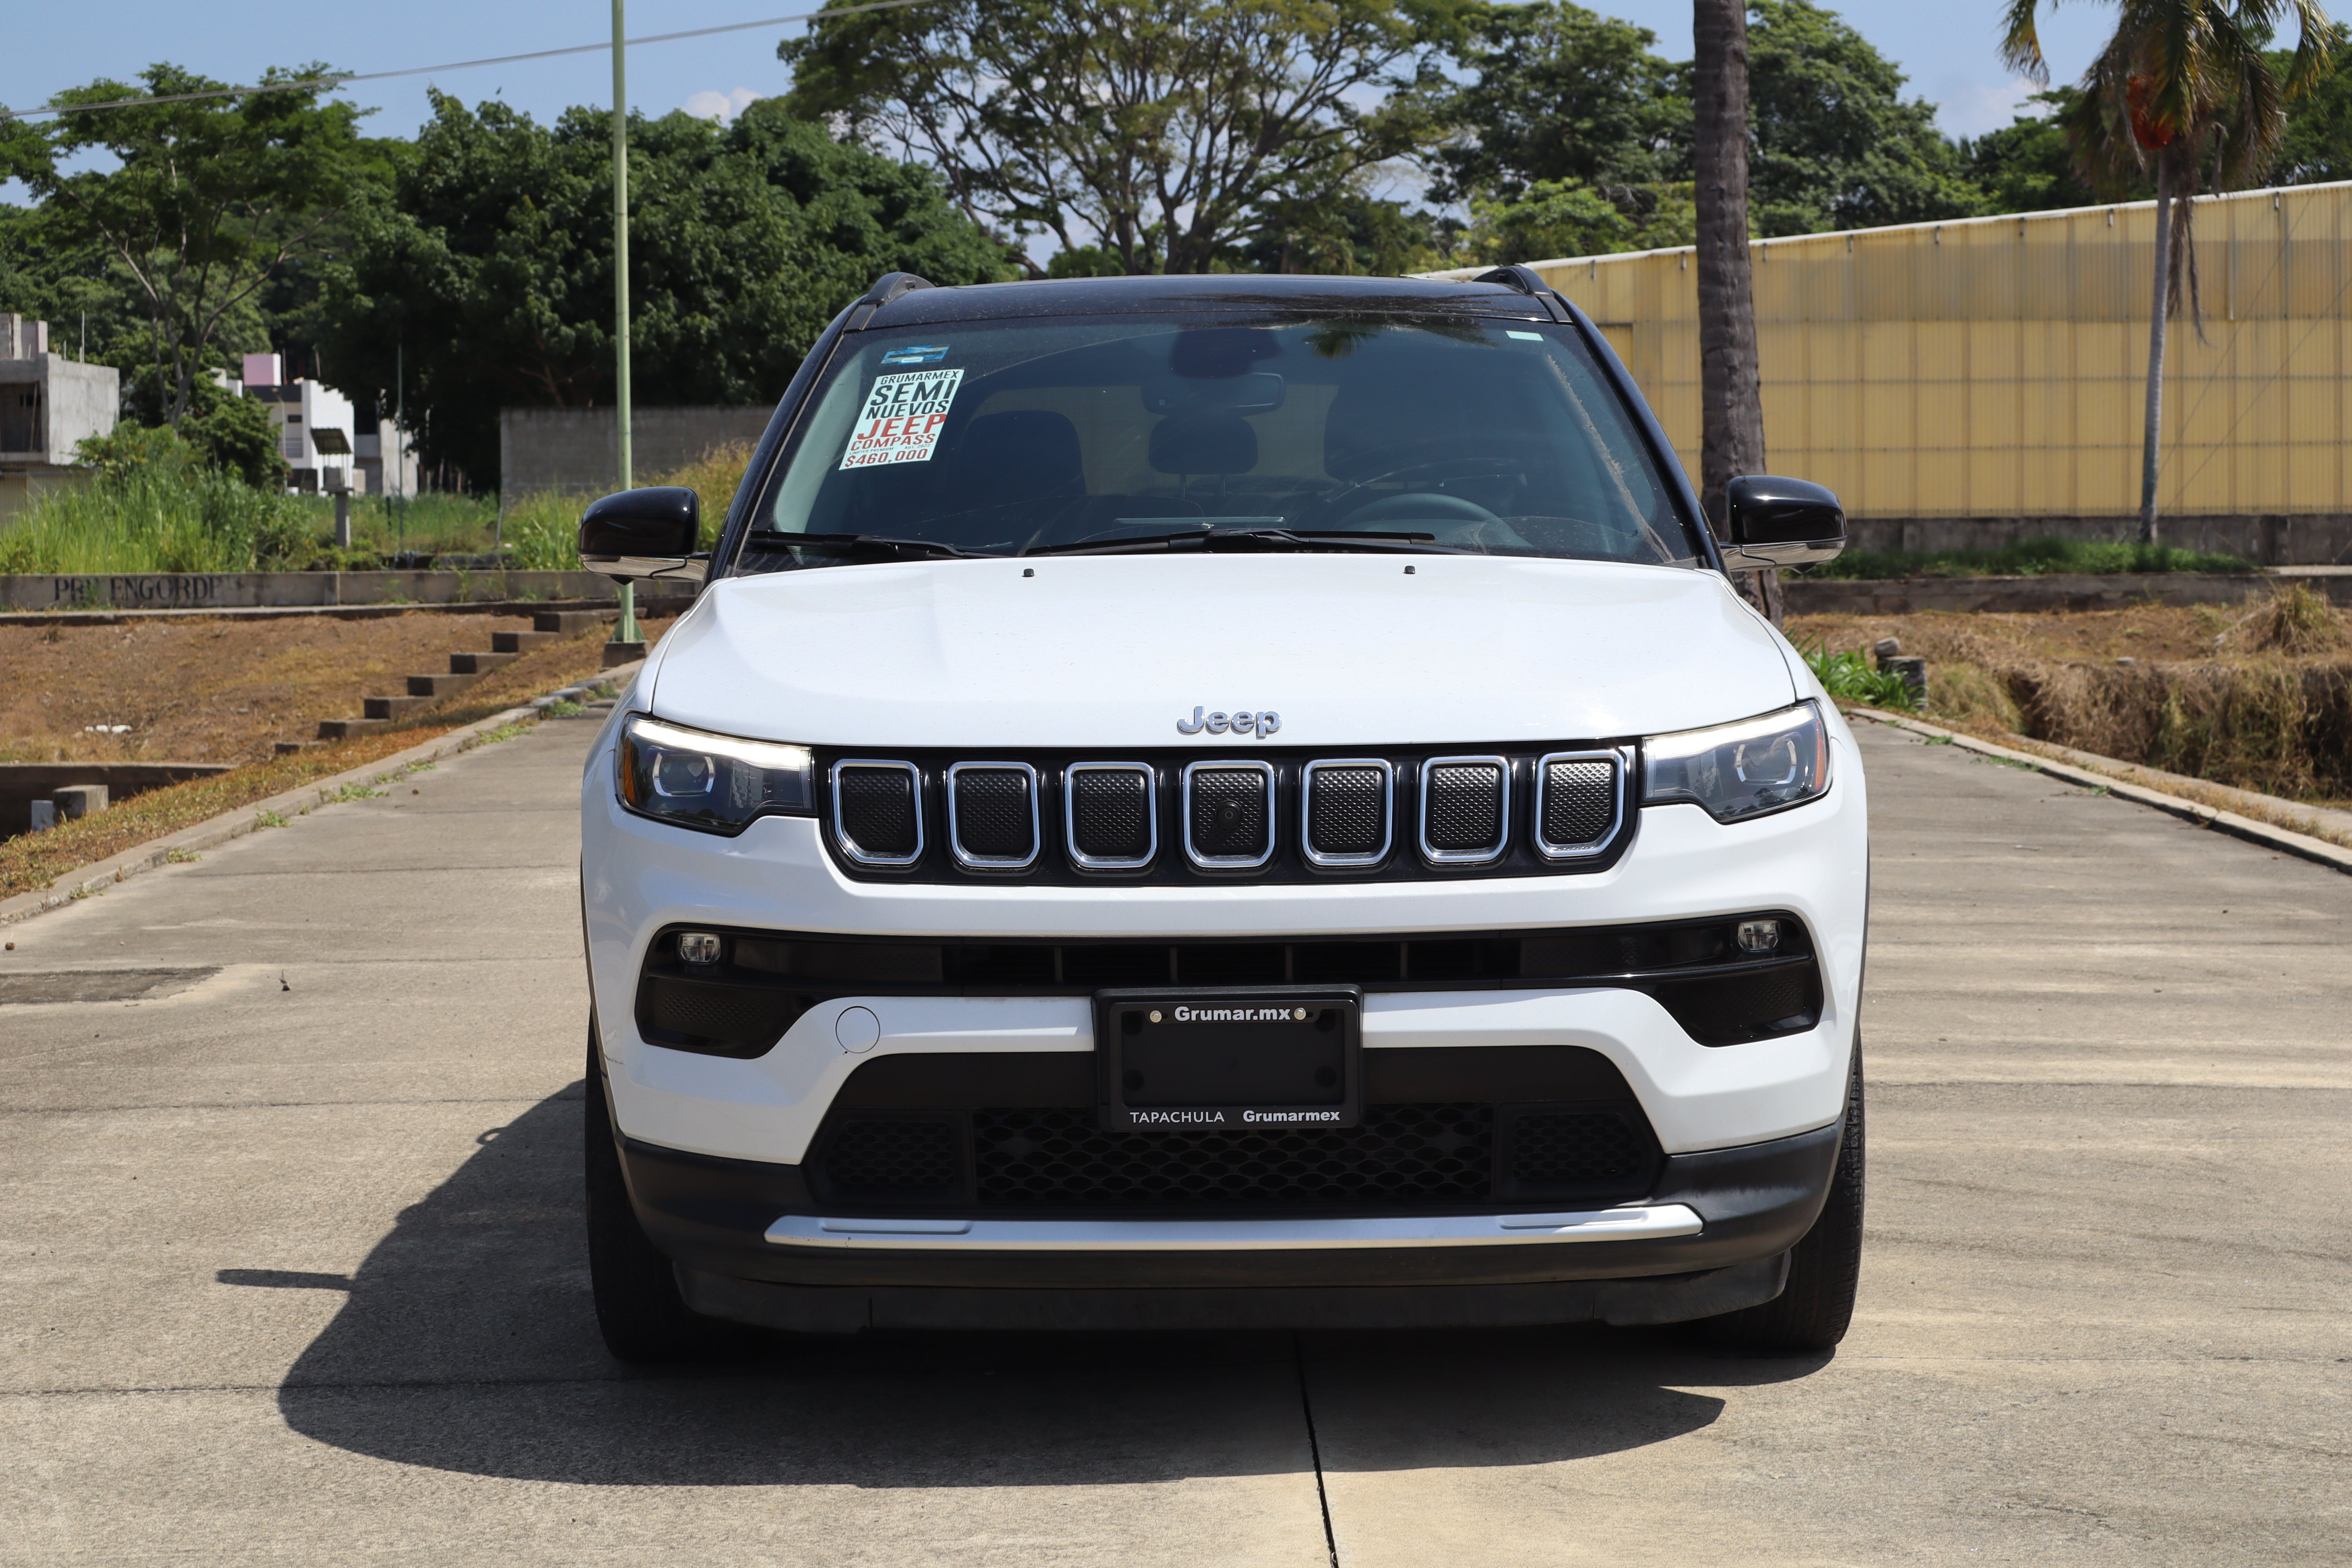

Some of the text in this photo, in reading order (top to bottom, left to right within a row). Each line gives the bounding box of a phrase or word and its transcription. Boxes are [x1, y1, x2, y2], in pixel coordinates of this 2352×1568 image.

[880, 370, 959, 385] GRUMARMEX
[870, 379, 956, 406] SEMI
[866, 400, 949, 420] NUEVOS
[857, 414, 947, 440] JEEP
[851, 434, 936, 451] COMPASS
[845, 449, 928, 467] $460,000
[54, 577, 99, 601] PR
[1178, 706, 1282, 739] Jeep
[1174, 1005, 1291, 1022] Grumar.mx
[1130, 1110, 1340, 1123] TAPACHULA Grumarmex
